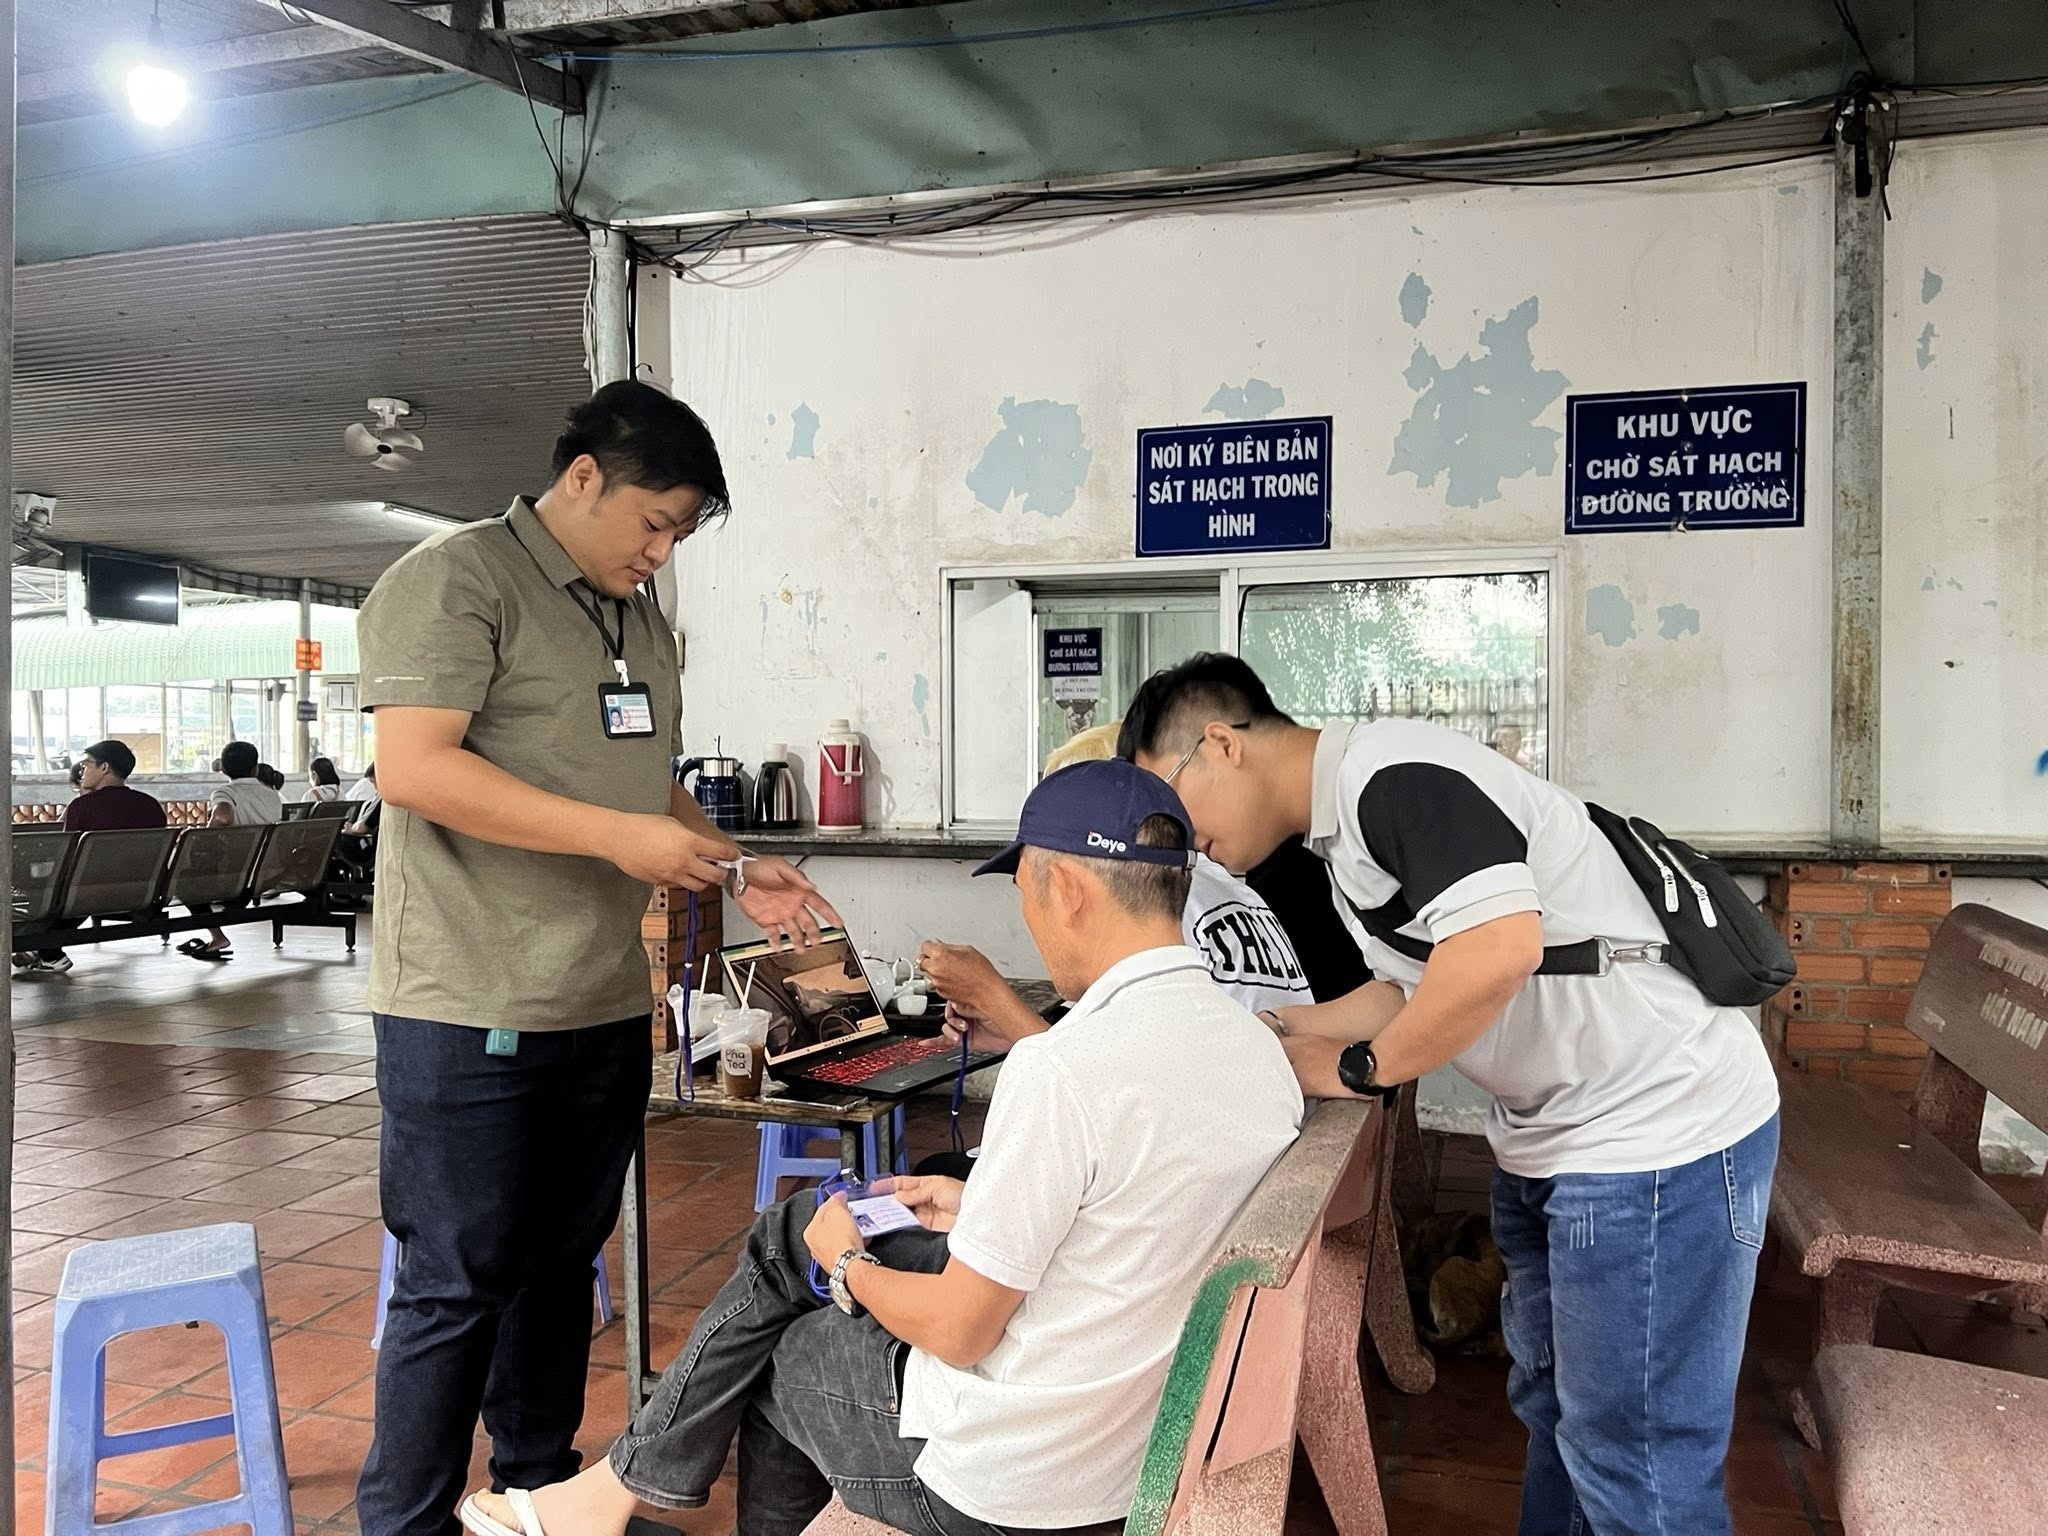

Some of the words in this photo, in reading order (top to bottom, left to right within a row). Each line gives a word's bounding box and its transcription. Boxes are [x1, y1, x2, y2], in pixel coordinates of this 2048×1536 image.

[1617, 413, 1679, 440] KHU
[1690, 405, 1752, 439] VỰC
[1151, 442, 1182, 470] NƠI
[1189, 437, 1215, 467] KÝ
[1222, 434, 1269, 464] BIÊN
[1276, 428, 1318, 462] BẢN
[1586, 452, 1640, 480] CHỜ
[1648, 450, 1698, 477] SÁT
[1709, 451, 1782, 478] HẠCH
[1149, 475, 1185, 505] SÁT
[1192, 477, 1245, 506] HẠCH
[1252, 472, 1319, 498] TRONG
[1581, 488, 1670, 515] ĐƯỜNG
[1678, 483, 1788, 512] TRƯỜNG
[1209, 509, 1255, 538] HÌNH
[1087, 831, 1127, 854] Deye
[726, 1059, 746, 1069] Tea
